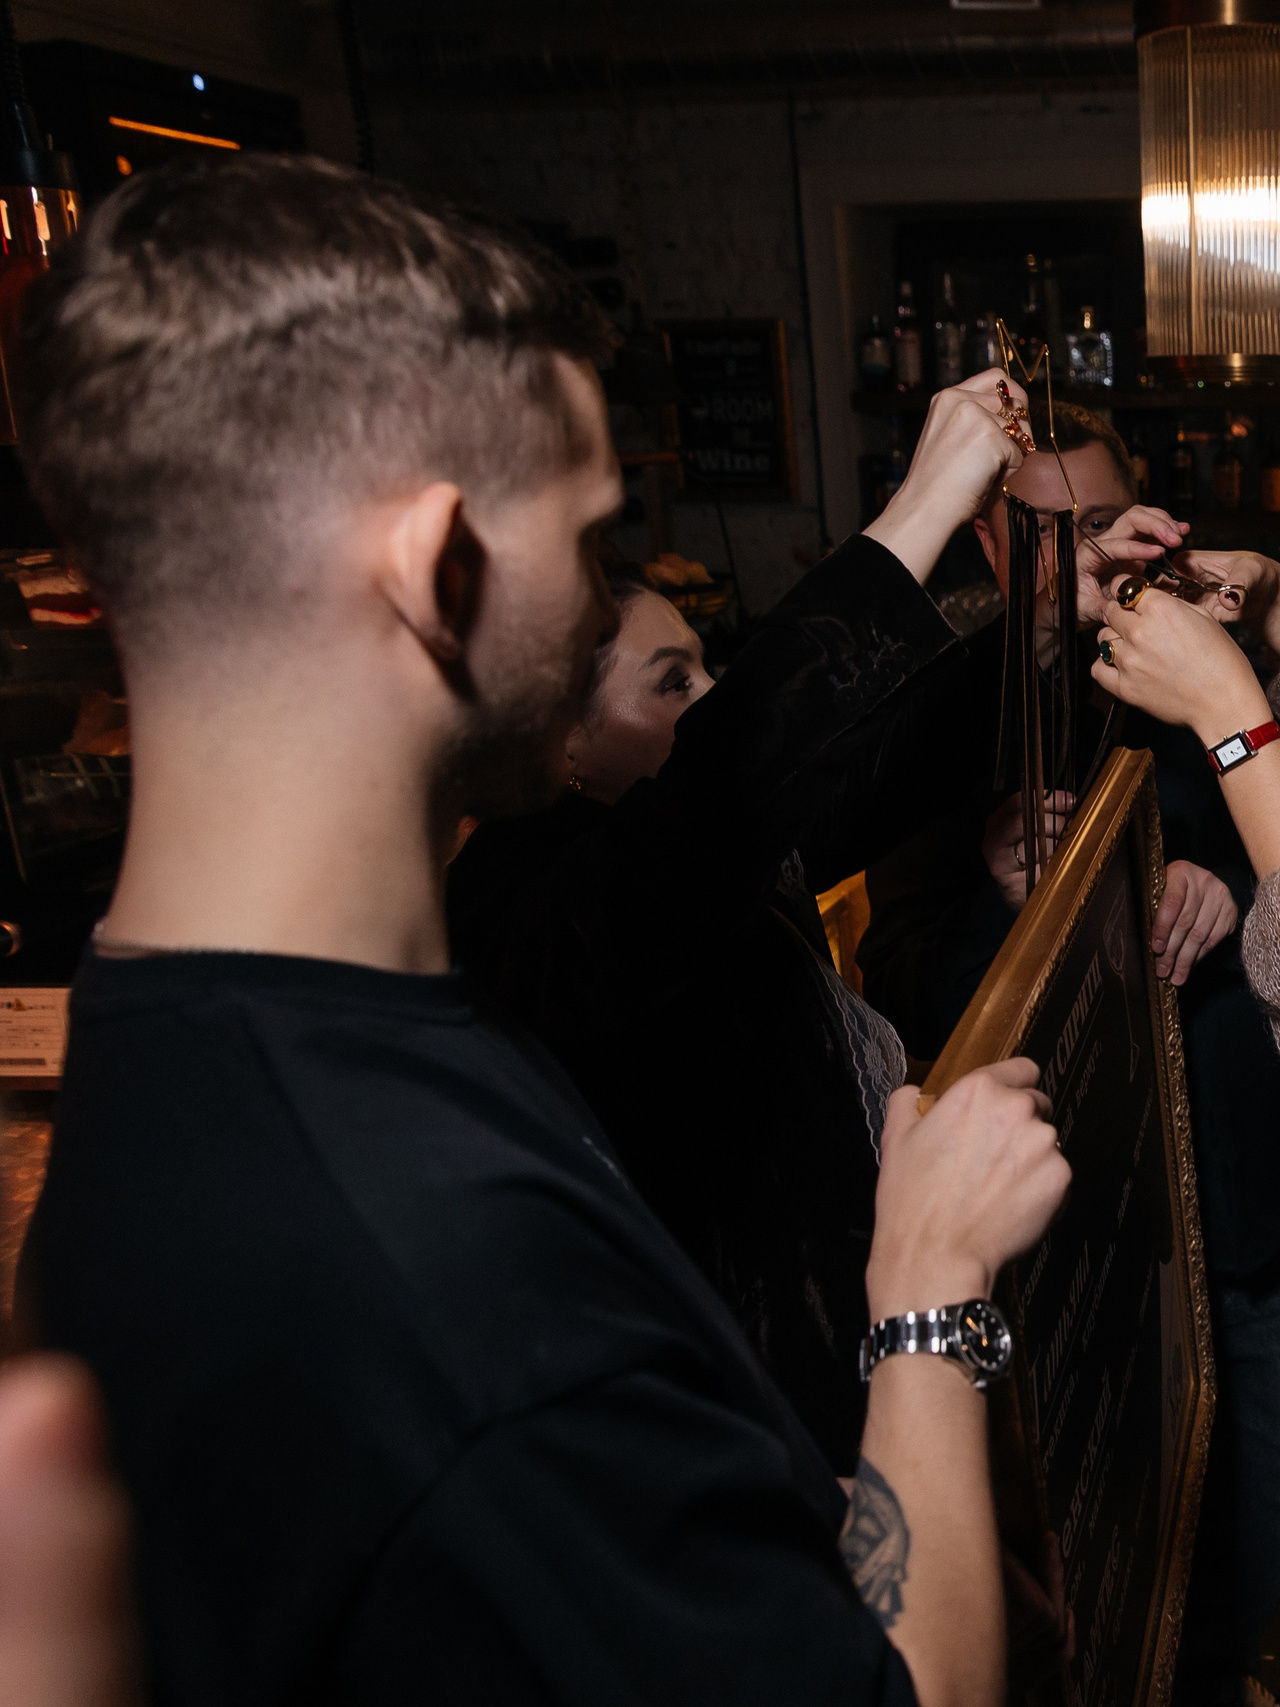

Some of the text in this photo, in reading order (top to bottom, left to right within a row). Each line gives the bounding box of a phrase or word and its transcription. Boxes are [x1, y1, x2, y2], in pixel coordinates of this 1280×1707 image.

[711, 396, 774, 423] ROOM
[695, 448, 770, 472] Wine
[1056, 951, 1102, 1077] СПРИТЦ
[1017, 1229, 1051, 1328] узина/
[1060, 1360, 1112, 1569] енский
